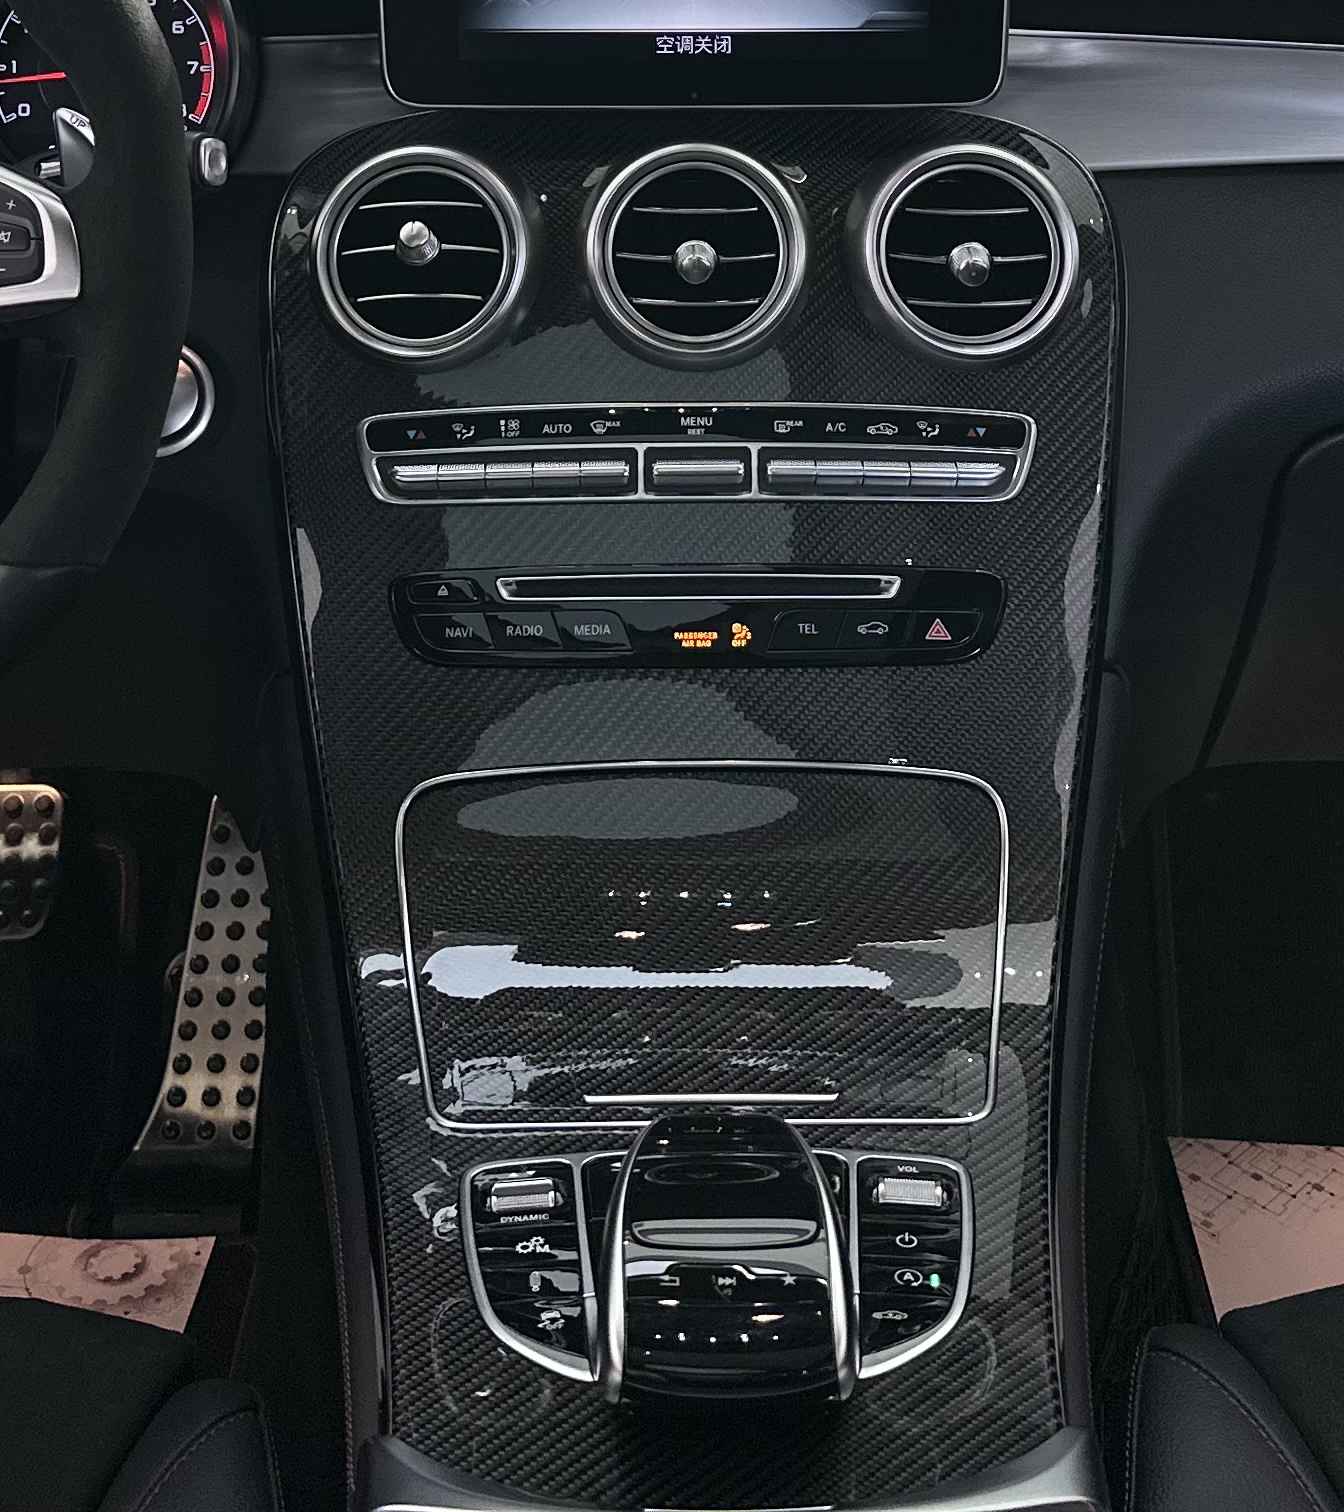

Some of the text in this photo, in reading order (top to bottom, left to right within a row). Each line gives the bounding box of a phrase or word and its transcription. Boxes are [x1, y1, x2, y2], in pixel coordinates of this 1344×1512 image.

[172, 21, 184, 34] 6
[655, 35, 732, 55] 空调关闭
[11, 60, 17, 74] 1
[187, 61, 199, 75] 7
[17, 103, 31, 117] 0
[69, 114, 86, 129] UP
[680, 417, 713, 427] MENU
[825, 422, 846, 433] A/C
[542, 423, 572, 434] AUTO
[687, 428, 706, 436] REST
[445, 627, 473, 638] NAVI
[506, 625, 543, 637] RADIO
[574, 624, 611, 636] MEDIA
[798, 623, 818, 634] TEL
[674, 631, 718, 640] PASSENGER
[731, 640, 747, 648] OFF
[897, 1165, 919, 1173] VOL
[500, 1213, 550, 1224] DYNAMIC
